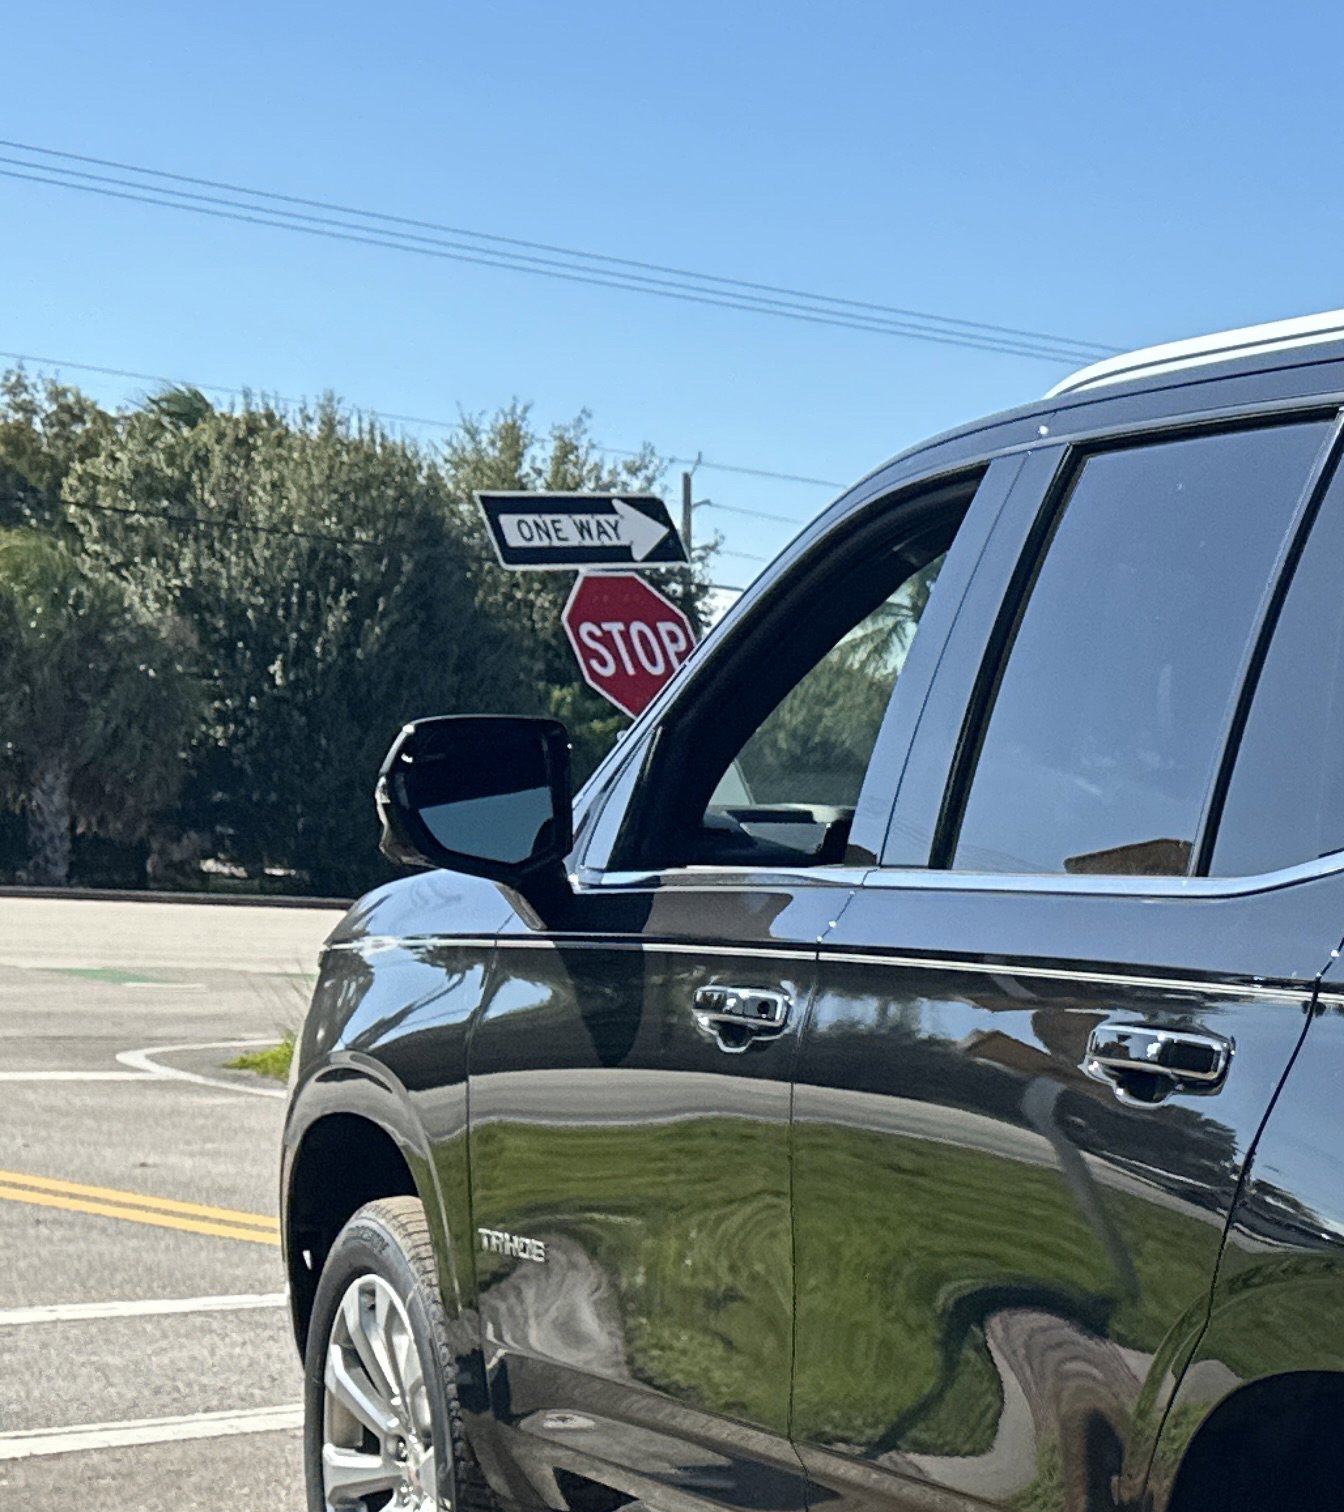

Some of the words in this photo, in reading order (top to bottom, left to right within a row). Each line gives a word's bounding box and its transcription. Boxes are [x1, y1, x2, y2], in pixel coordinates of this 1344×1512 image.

[517, 519, 568, 542] ONE
[573, 519, 622, 541] WAY
[579, 620, 688, 677] STOP
[478, 1227, 545, 1262] TAHOE
